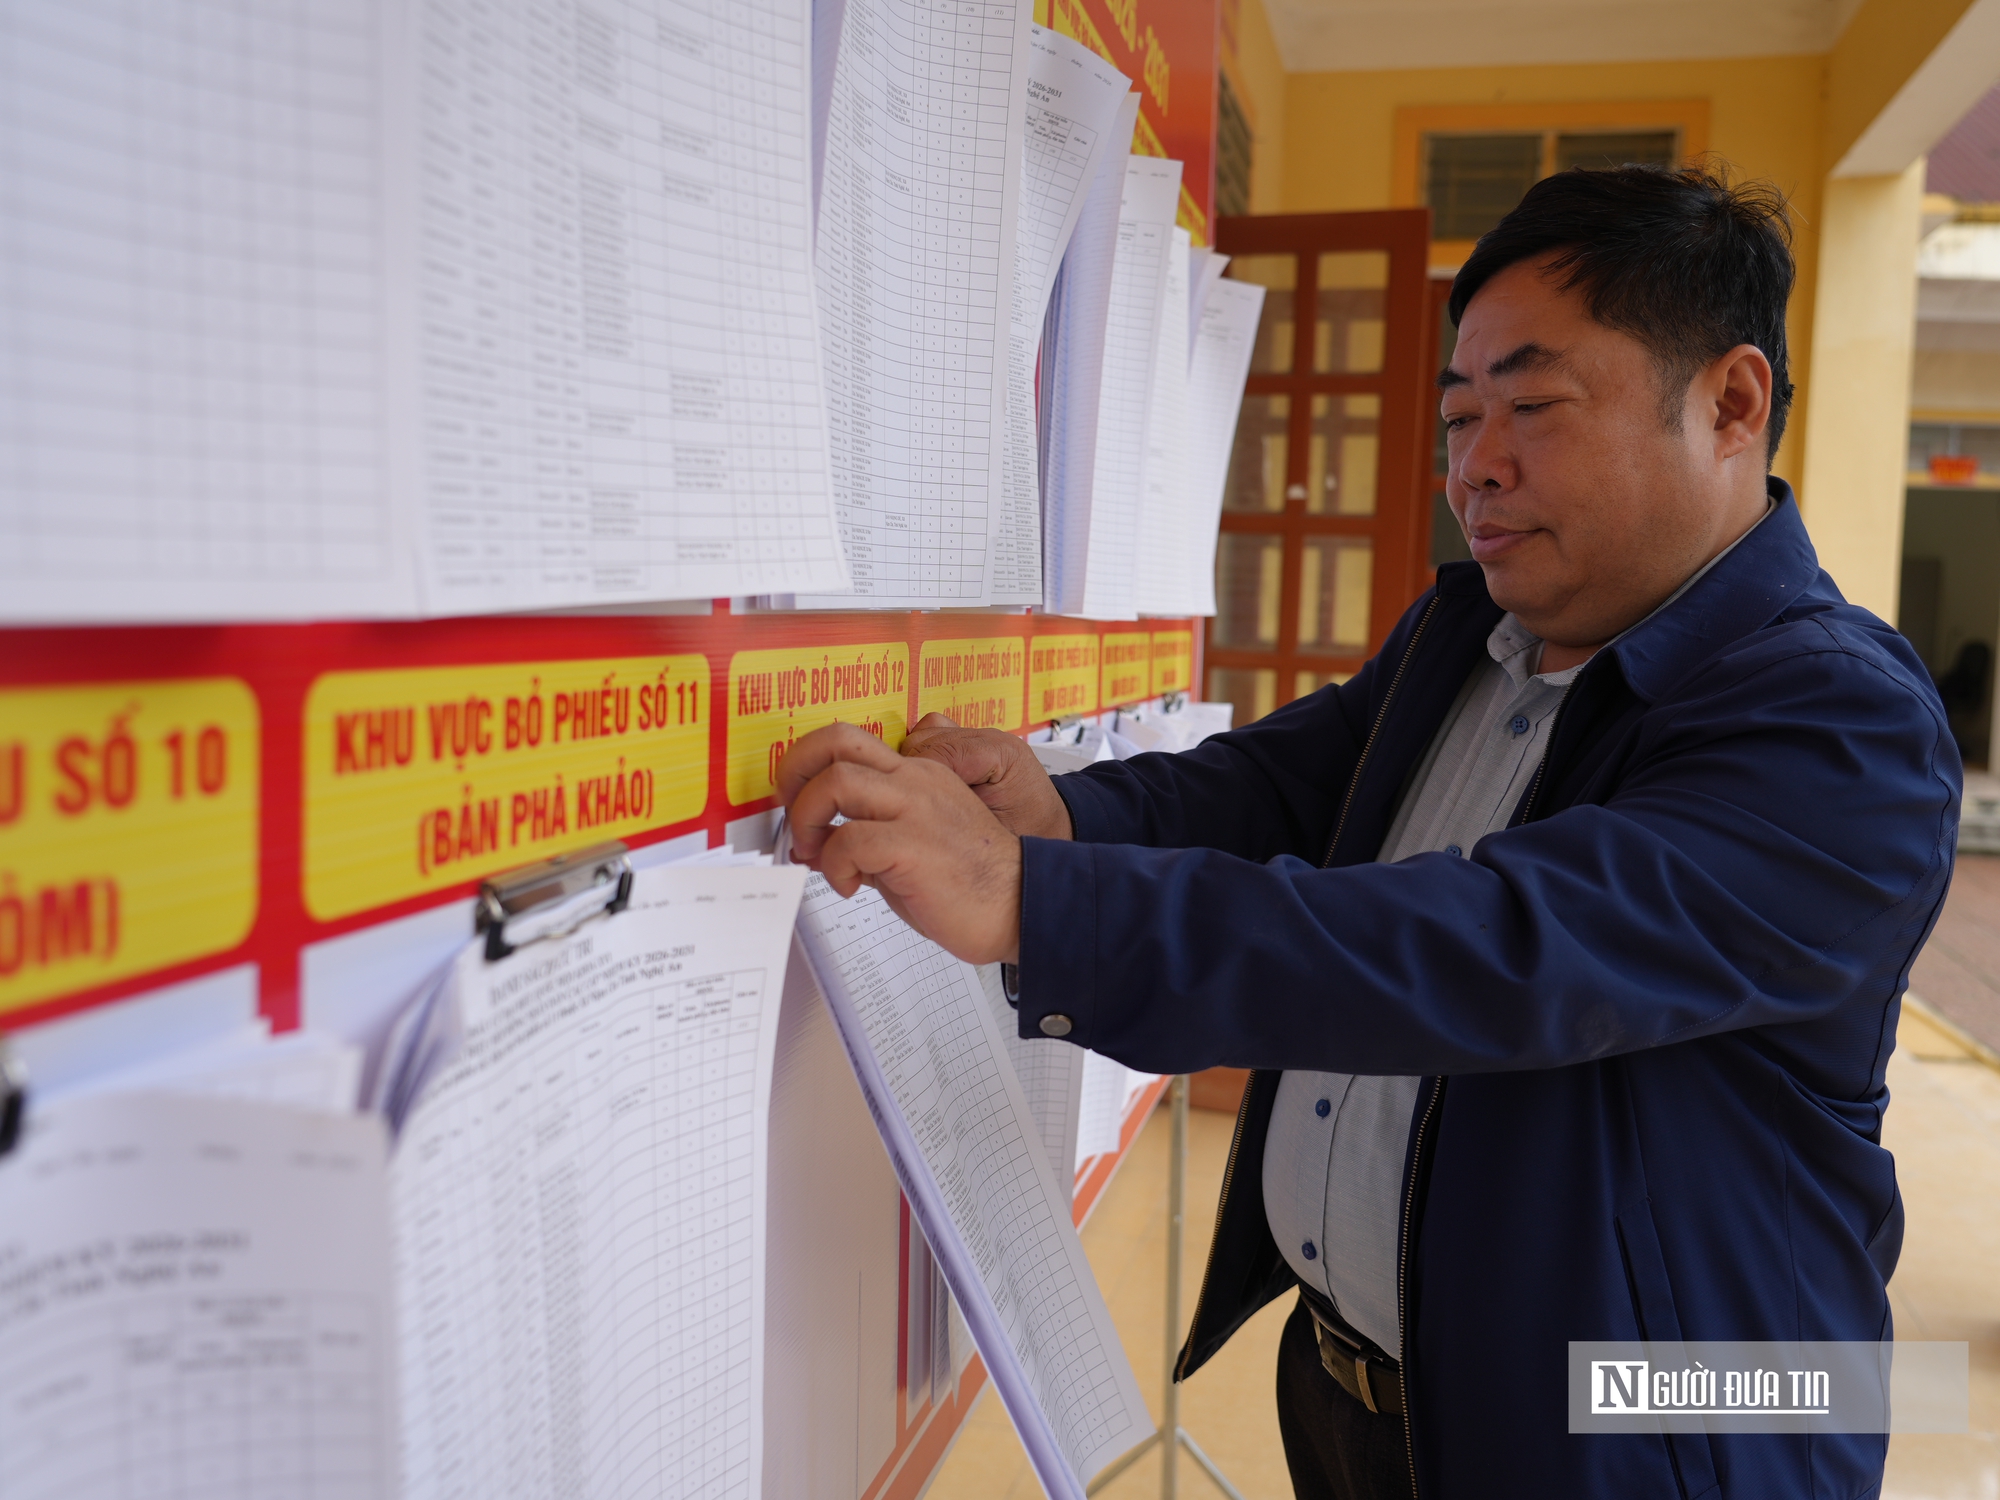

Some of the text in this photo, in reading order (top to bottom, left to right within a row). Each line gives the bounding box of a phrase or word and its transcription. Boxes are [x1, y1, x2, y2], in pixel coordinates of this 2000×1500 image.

[335, 665, 698, 776] KHU VỰC BỎ PHIẾU SỐ 11
[738, 649, 904, 718] KHU VỰC BỎ PHIẾU SỐ 12
[924, 642, 1021, 691] KHU VỰC BỎ PHIẾU SỐ 13
[54, 698, 142, 817] SỐ
[161, 723, 227, 799] 10
[419, 756, 654, 878] (BẢN PHÀ KHẢO)
